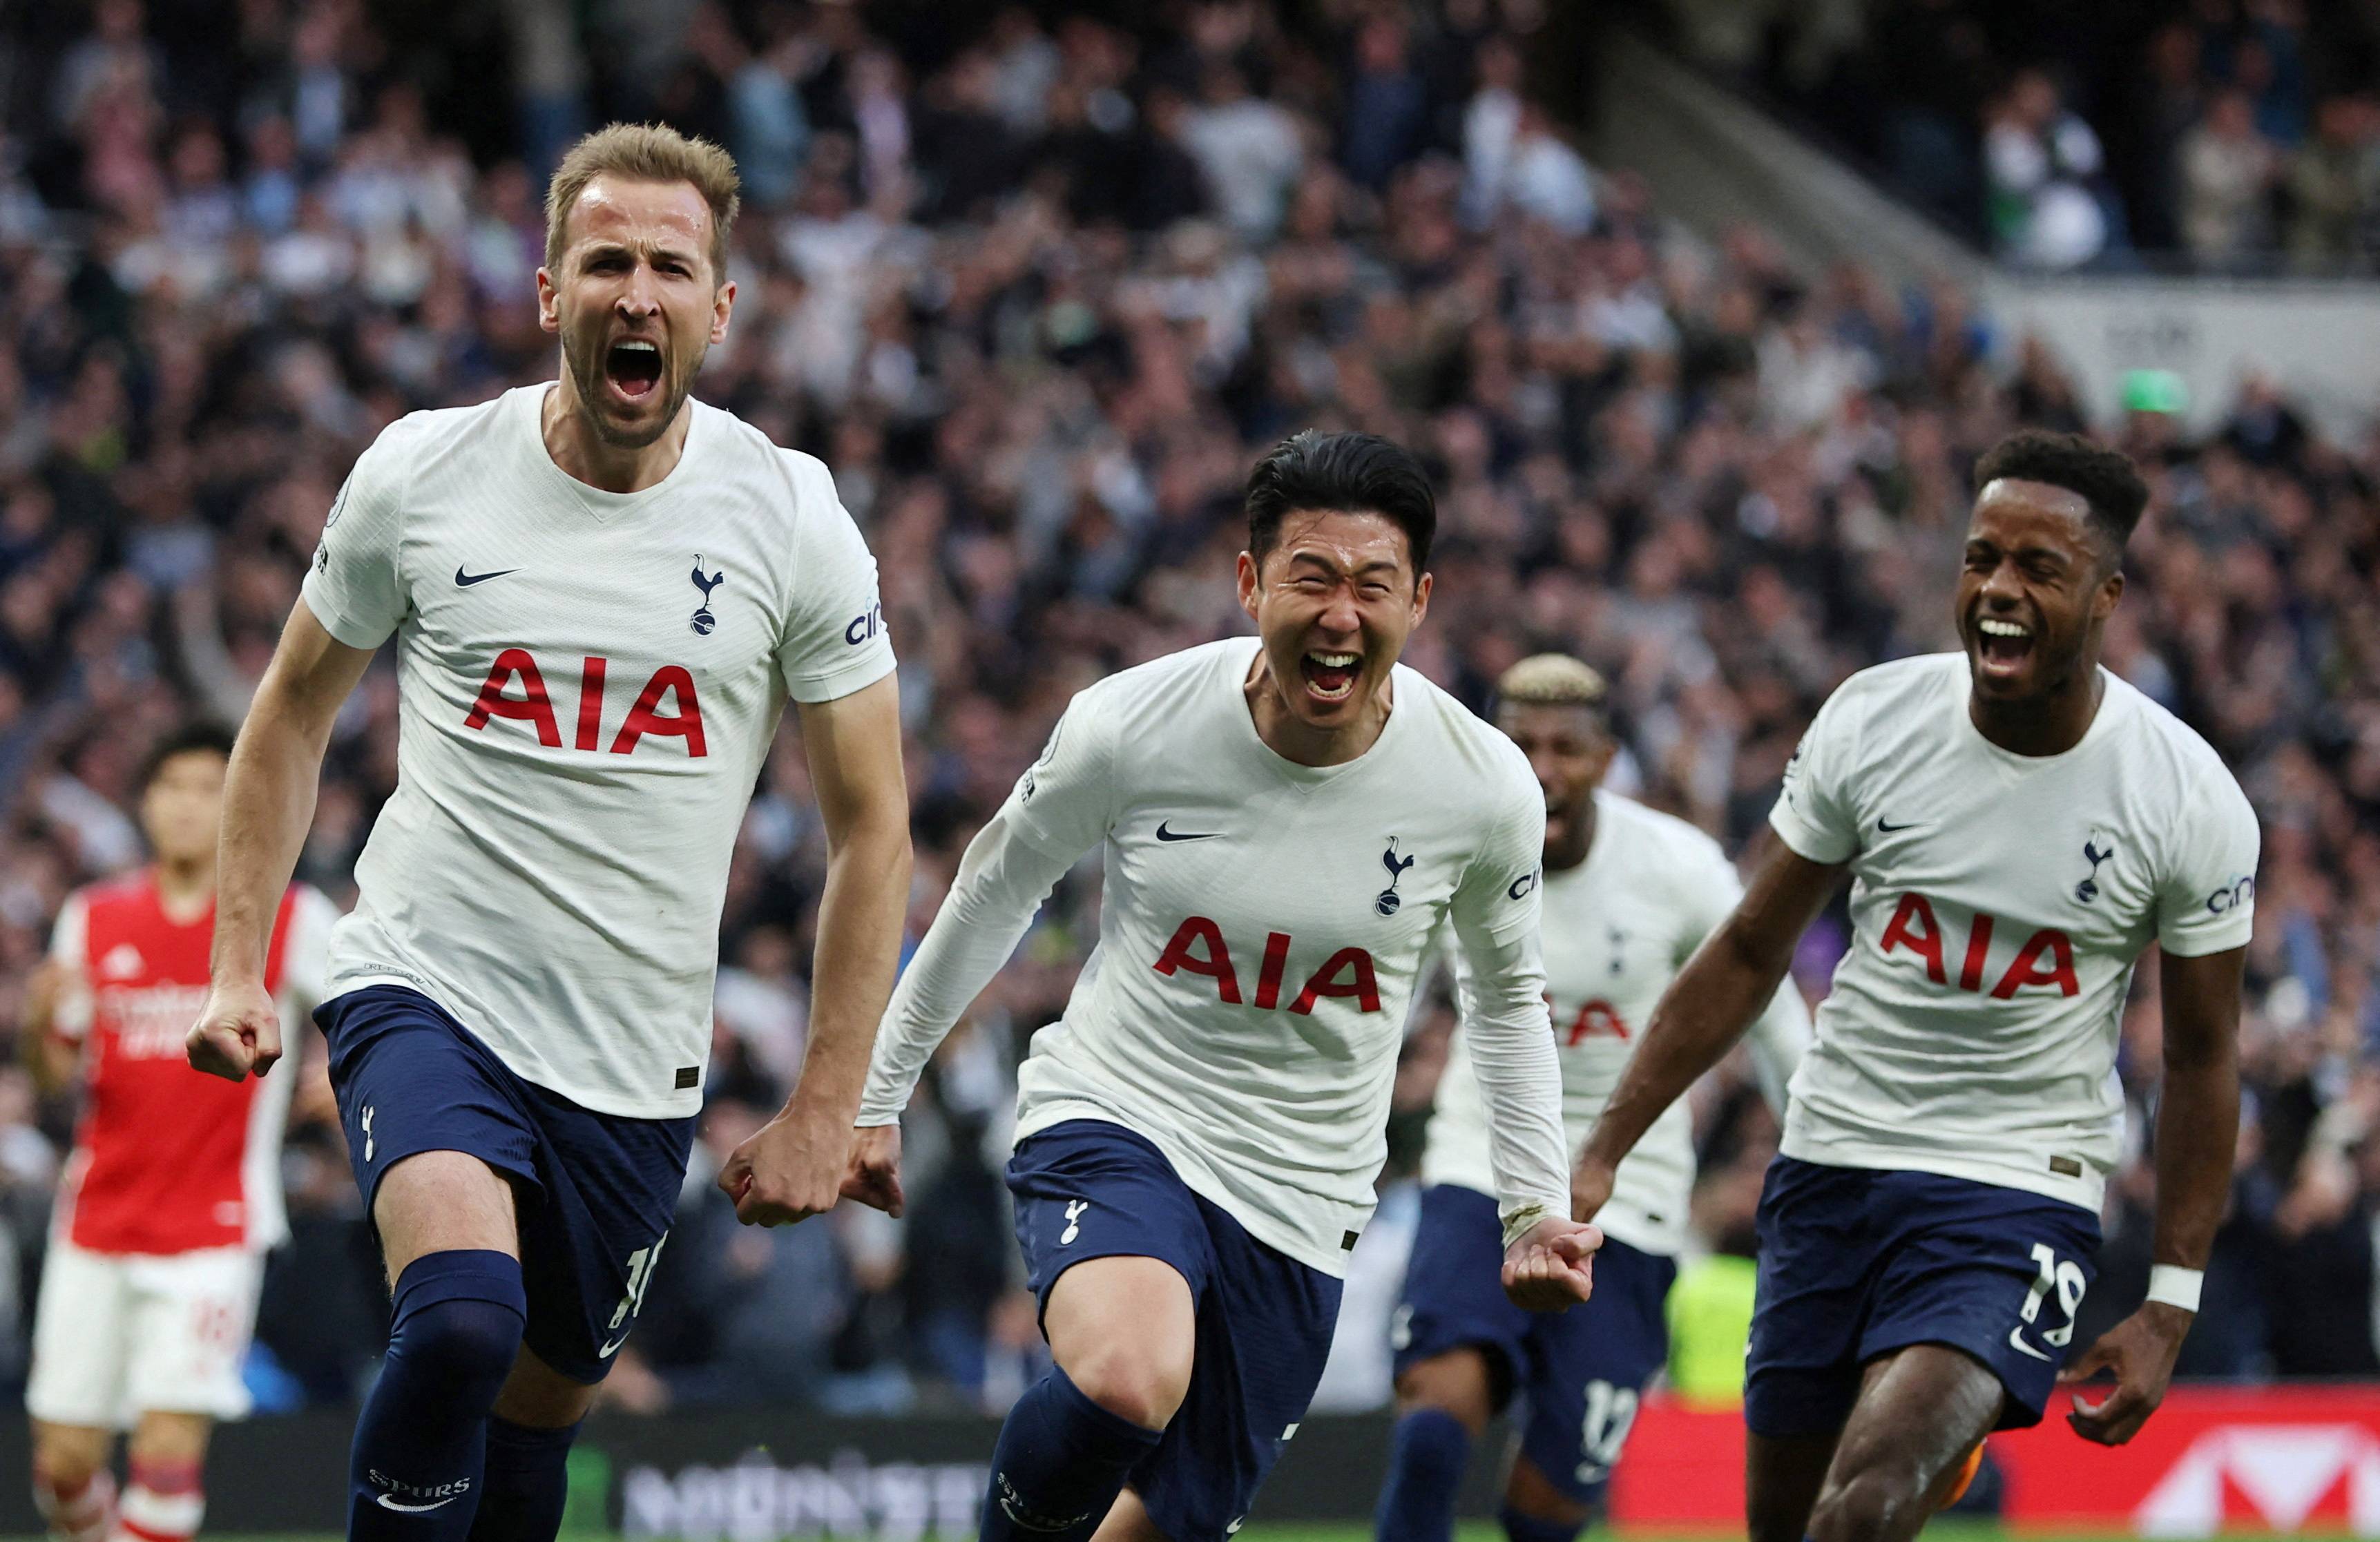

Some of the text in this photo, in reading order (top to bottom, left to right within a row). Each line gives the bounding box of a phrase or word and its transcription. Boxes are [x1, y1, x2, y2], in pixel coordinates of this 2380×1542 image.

[464, 648, 707, 758] AIA
[2207, 874, 2254, 914] cin
[1153, 916, 1381, 1016] AIA
[1880, 892, 2080, 1000] AIA
[2019, 1242, 2086, 1347] 19
[369, 1469, 470, 1498] SPURS
